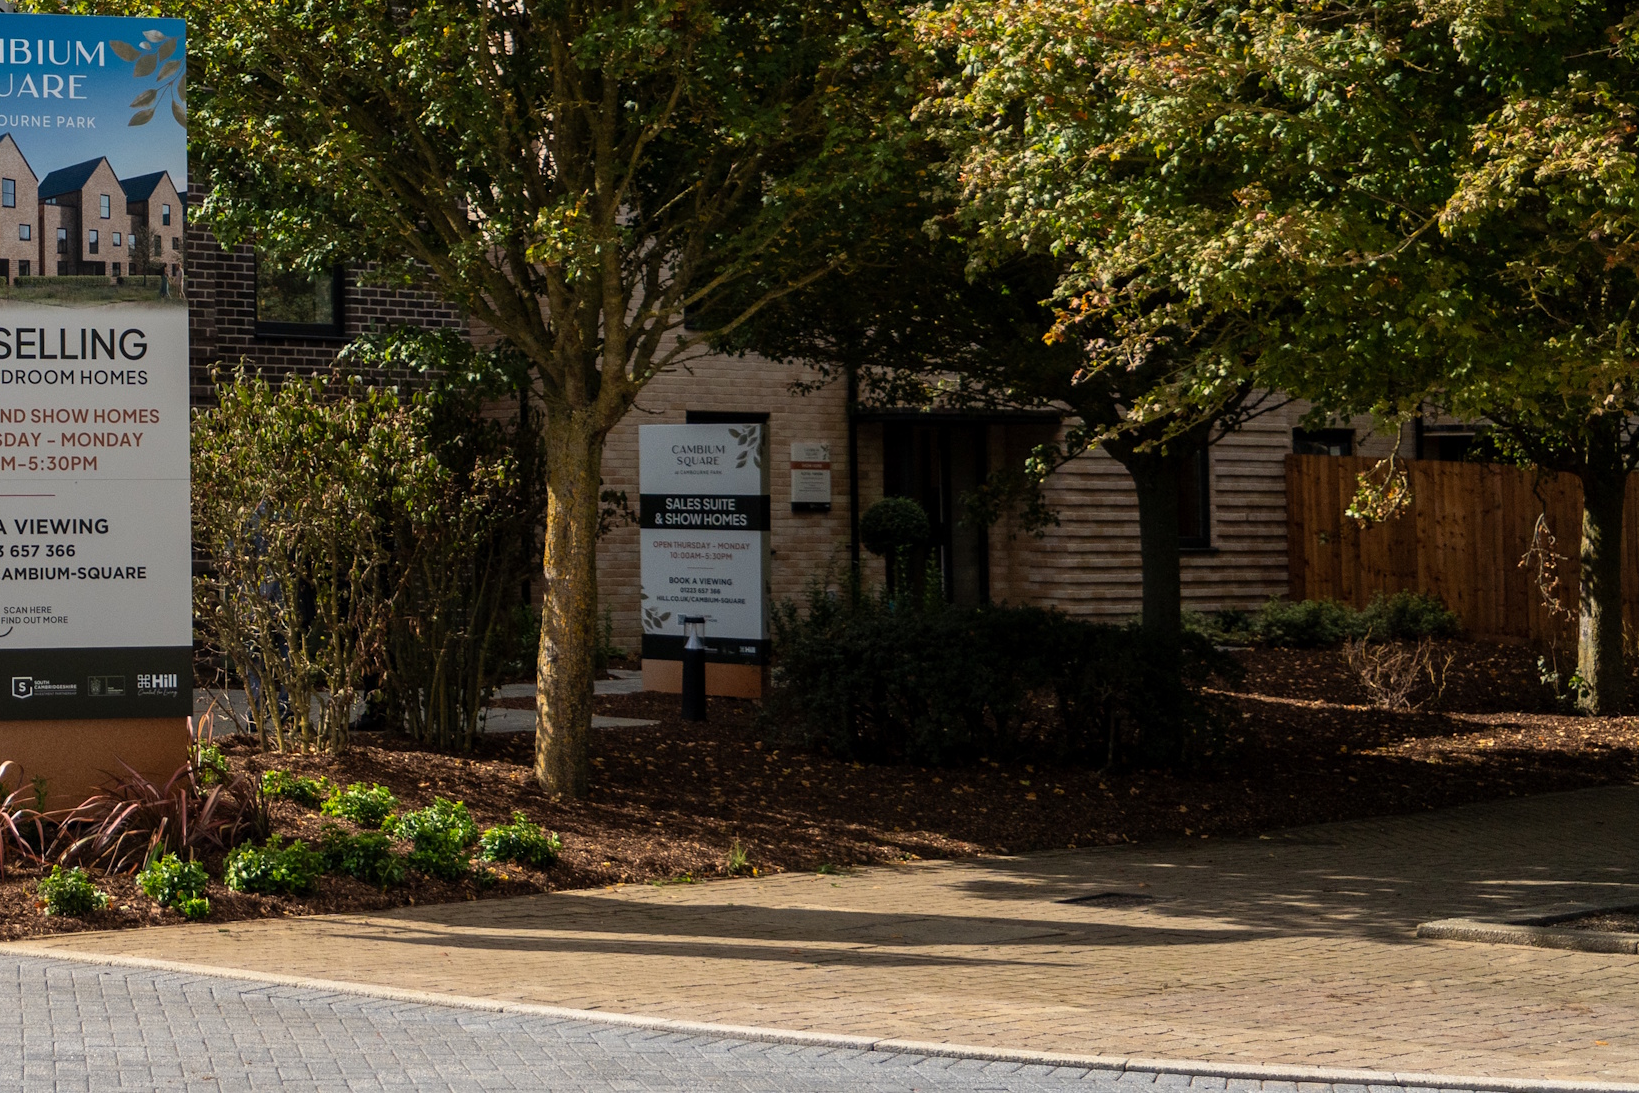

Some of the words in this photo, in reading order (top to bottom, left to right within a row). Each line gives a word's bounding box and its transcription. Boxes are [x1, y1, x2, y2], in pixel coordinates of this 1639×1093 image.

[57, 116, 96, 128] PARK
[80, 370, 148, 385] HOMES
[31, 409, 89, 424] SHOW
[94, 409, 160, 424] HOMES
[61, 432, 143, 448] MONDAY
[672, 445, 725, 454] CAMBIUM
[677, 457, 720, 466] SQUARE
[666, 498, 701, 510] SALES
[703, 499, 735, 510] SUITE
[655, 513, 662, 524] &
[665, 513, 702, 525] SHOW
[704, 514, 747, 526] HOMES
[14, 519, 109, 535] VIEWING
[10, 545, 40, 558] 657
[45, 544, 76, 558] 366
[653, 541, 672, 549] OPEN
[673, 541, 711, 549] THURSDAY
[718, 543, 750, 551] MONDAY
[657, 596, 745, 604] HILL.CO.UK/CAMBIUM-SQUARE
[1, 616, 20, 624] FIND
[19, 682, 26, 692] S
[152, 674, 177, 688] Hill
